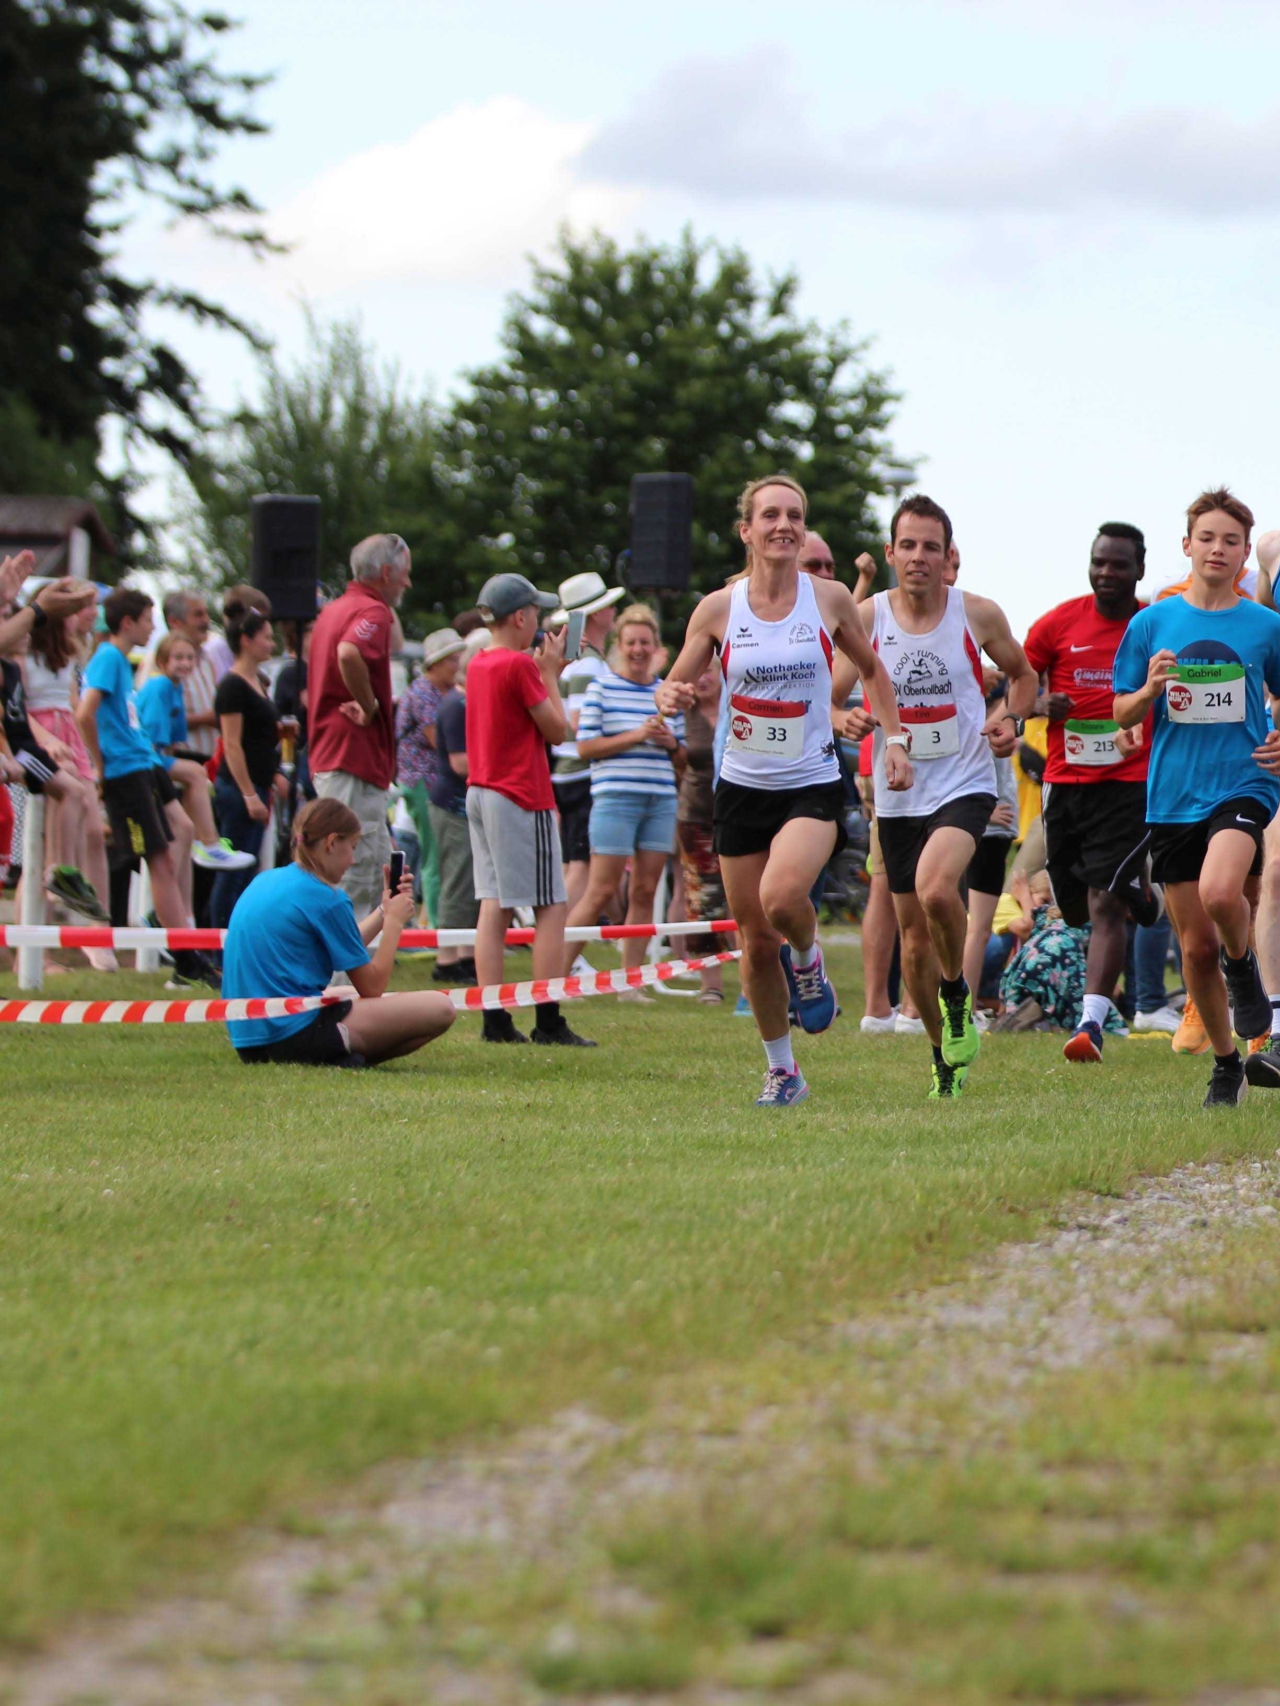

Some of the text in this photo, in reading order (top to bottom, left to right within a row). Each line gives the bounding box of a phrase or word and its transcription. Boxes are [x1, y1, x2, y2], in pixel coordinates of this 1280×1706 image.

[756, 661, 817, 675] Nothacker
[893, 652, 910, 675] cool
[917, 649, 948, 676] running
[761, 670, 815, 682] Klink Koch
[1187, 668, 1222, 678] Gabriel
[903, 678, 952, 696] Oberkollbach
[1169, 690, 1191, 698] WILD&
[1204, 691, 1233, 707] 214
[748, 701, 783, 713] Carmen
[766, 726, 787, 742] 33
[931, 730, 941, 744] 3
[1093, 740, 1115, 752] 213
